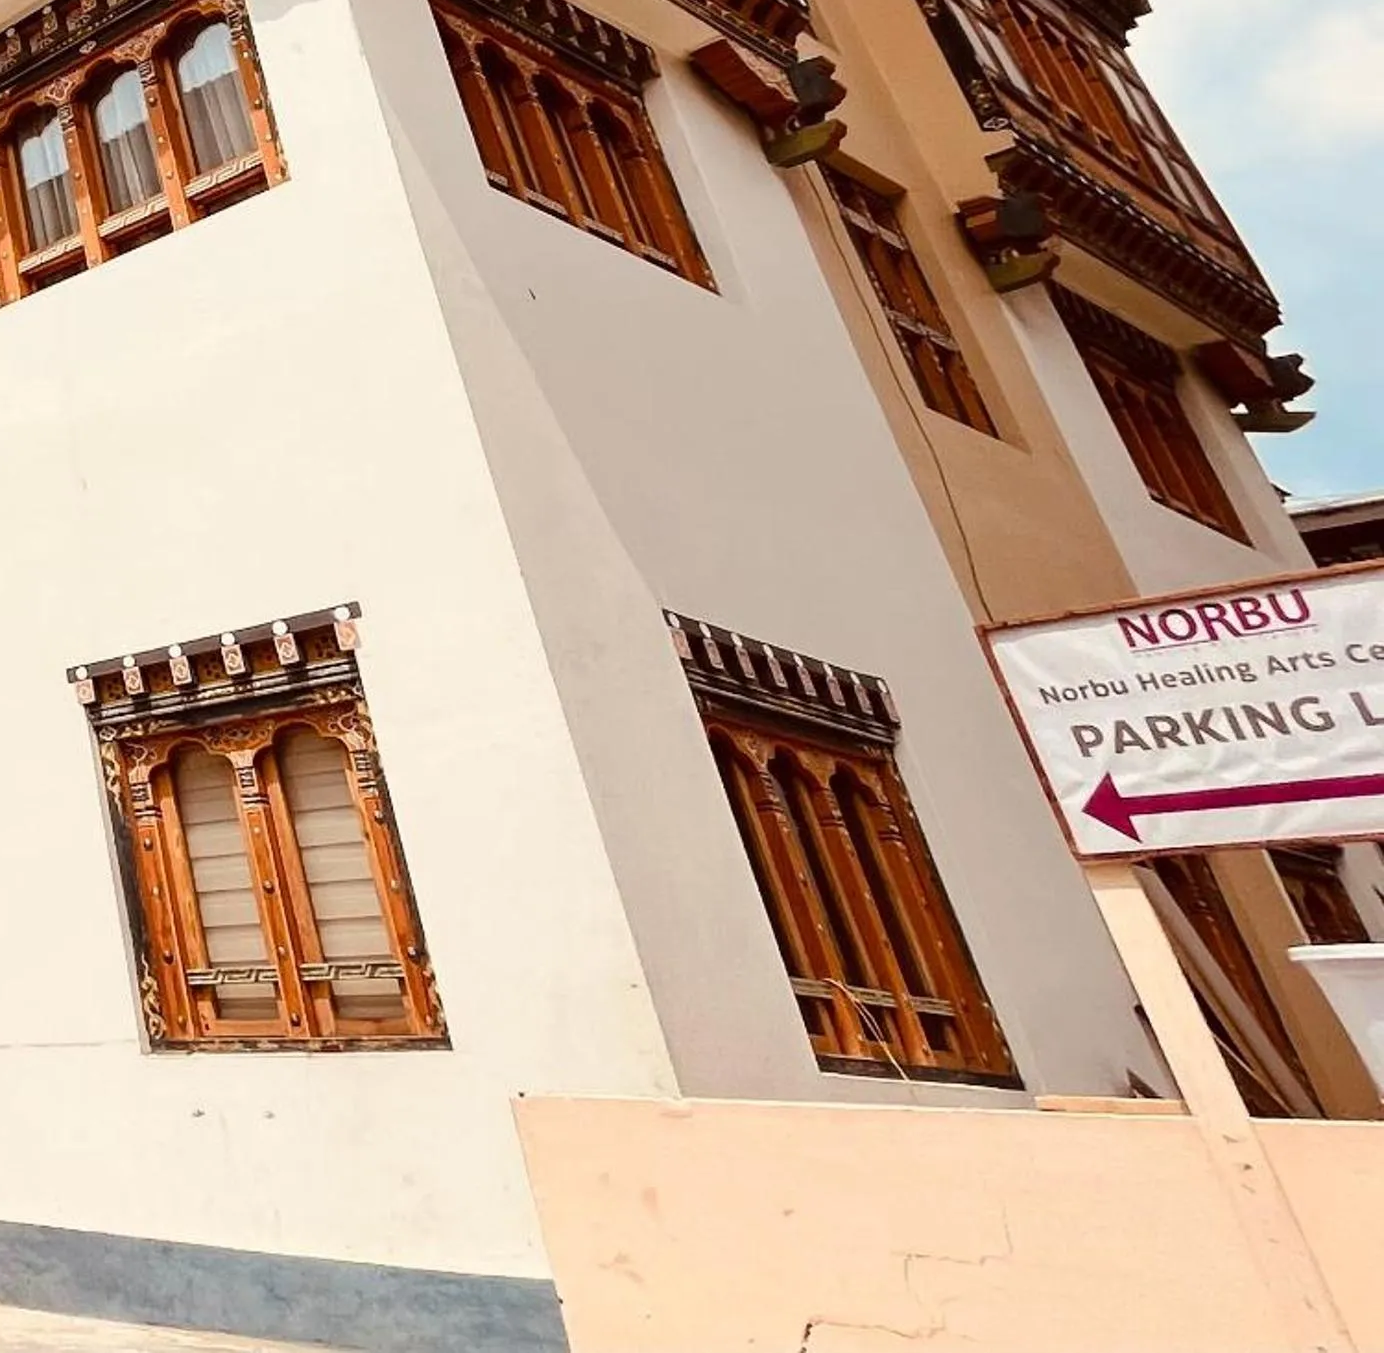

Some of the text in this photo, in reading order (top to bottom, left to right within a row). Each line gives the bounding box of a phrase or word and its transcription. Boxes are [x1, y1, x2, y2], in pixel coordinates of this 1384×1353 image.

[1117, 589, 1311, 647] NORBU
[1039, 679, 1128, 704] Norbu
[1136, 660, 1257, 692] Healing
[1268, 652, 1336, 675] Arts
[1071, 696, 1336, 758] PARKING
